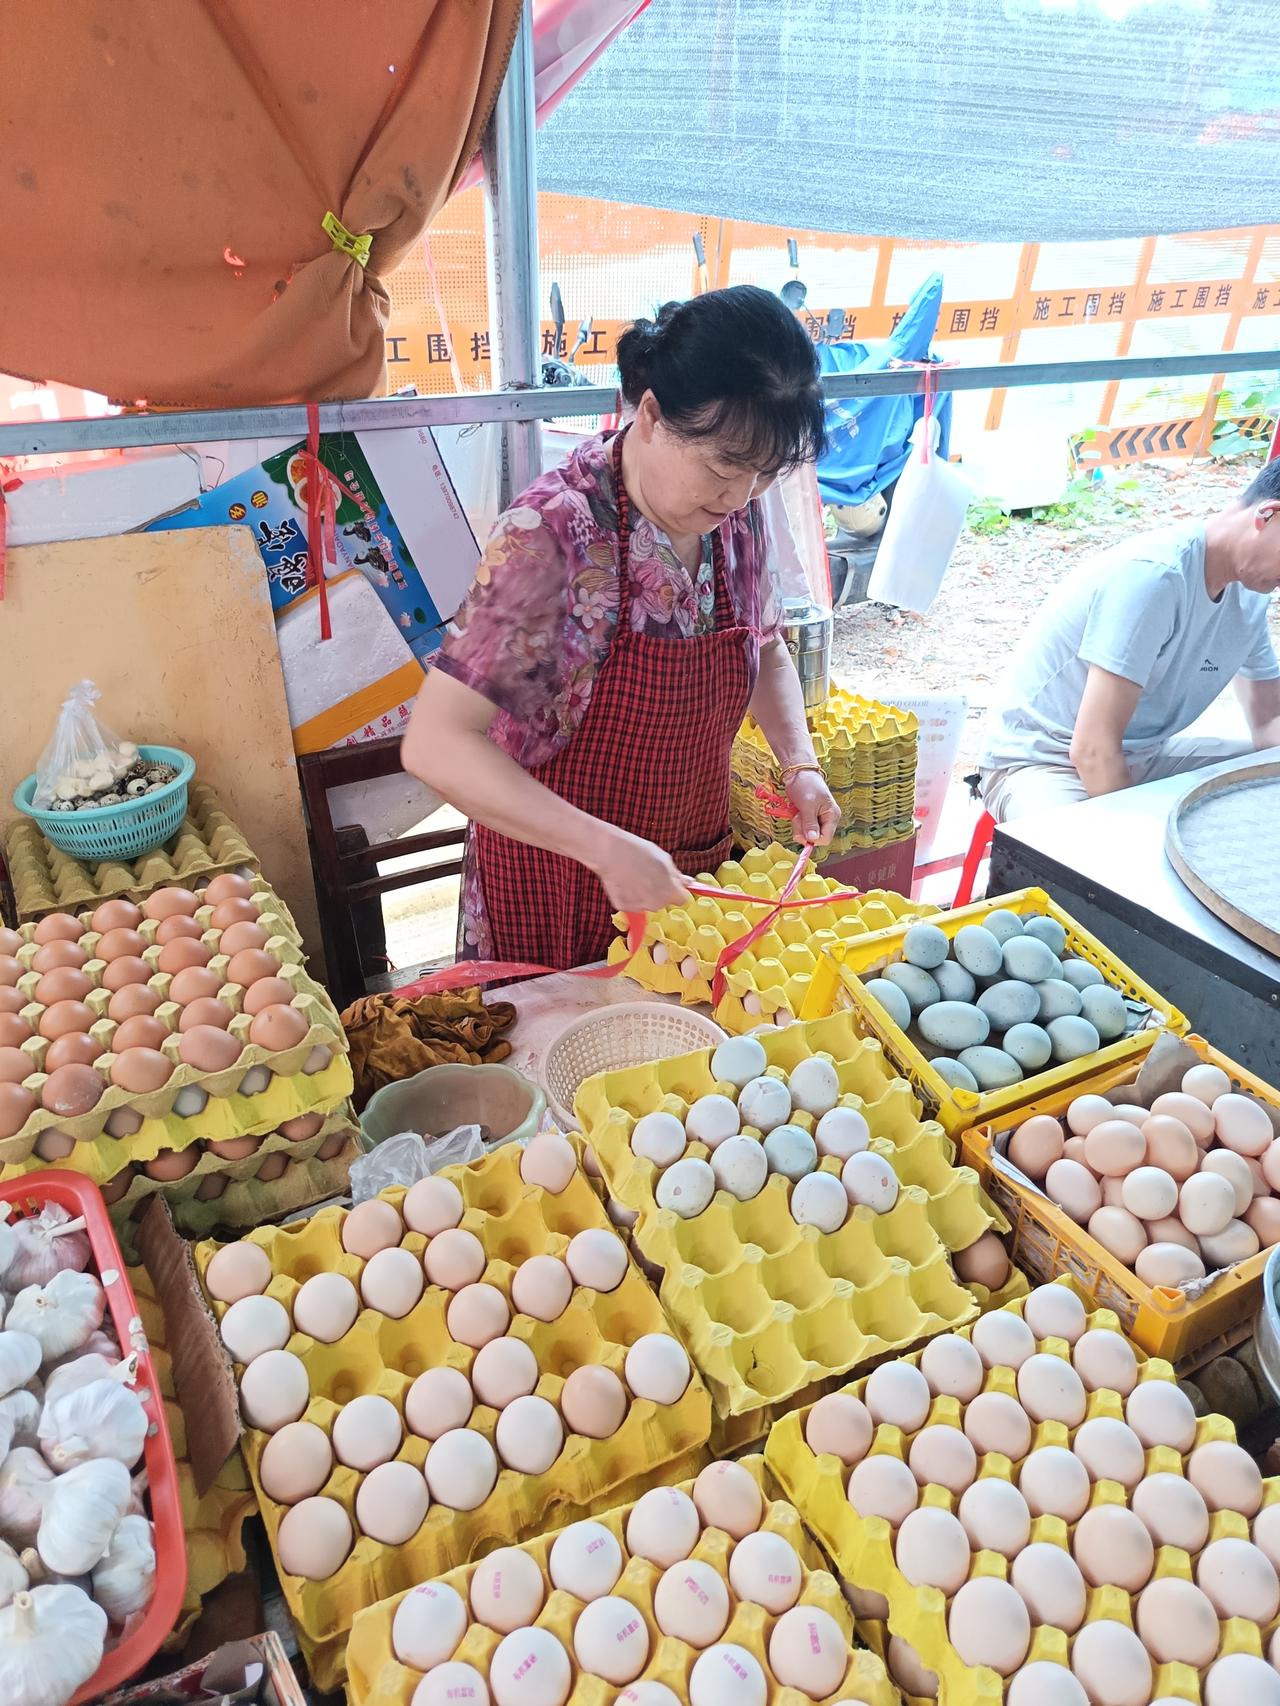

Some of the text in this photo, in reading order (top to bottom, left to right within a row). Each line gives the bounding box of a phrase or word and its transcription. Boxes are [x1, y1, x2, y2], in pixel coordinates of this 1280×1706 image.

[1032, 291, 1127, 321] 施工围挡
[1146, 284, 1233, 313] 施工围挡
